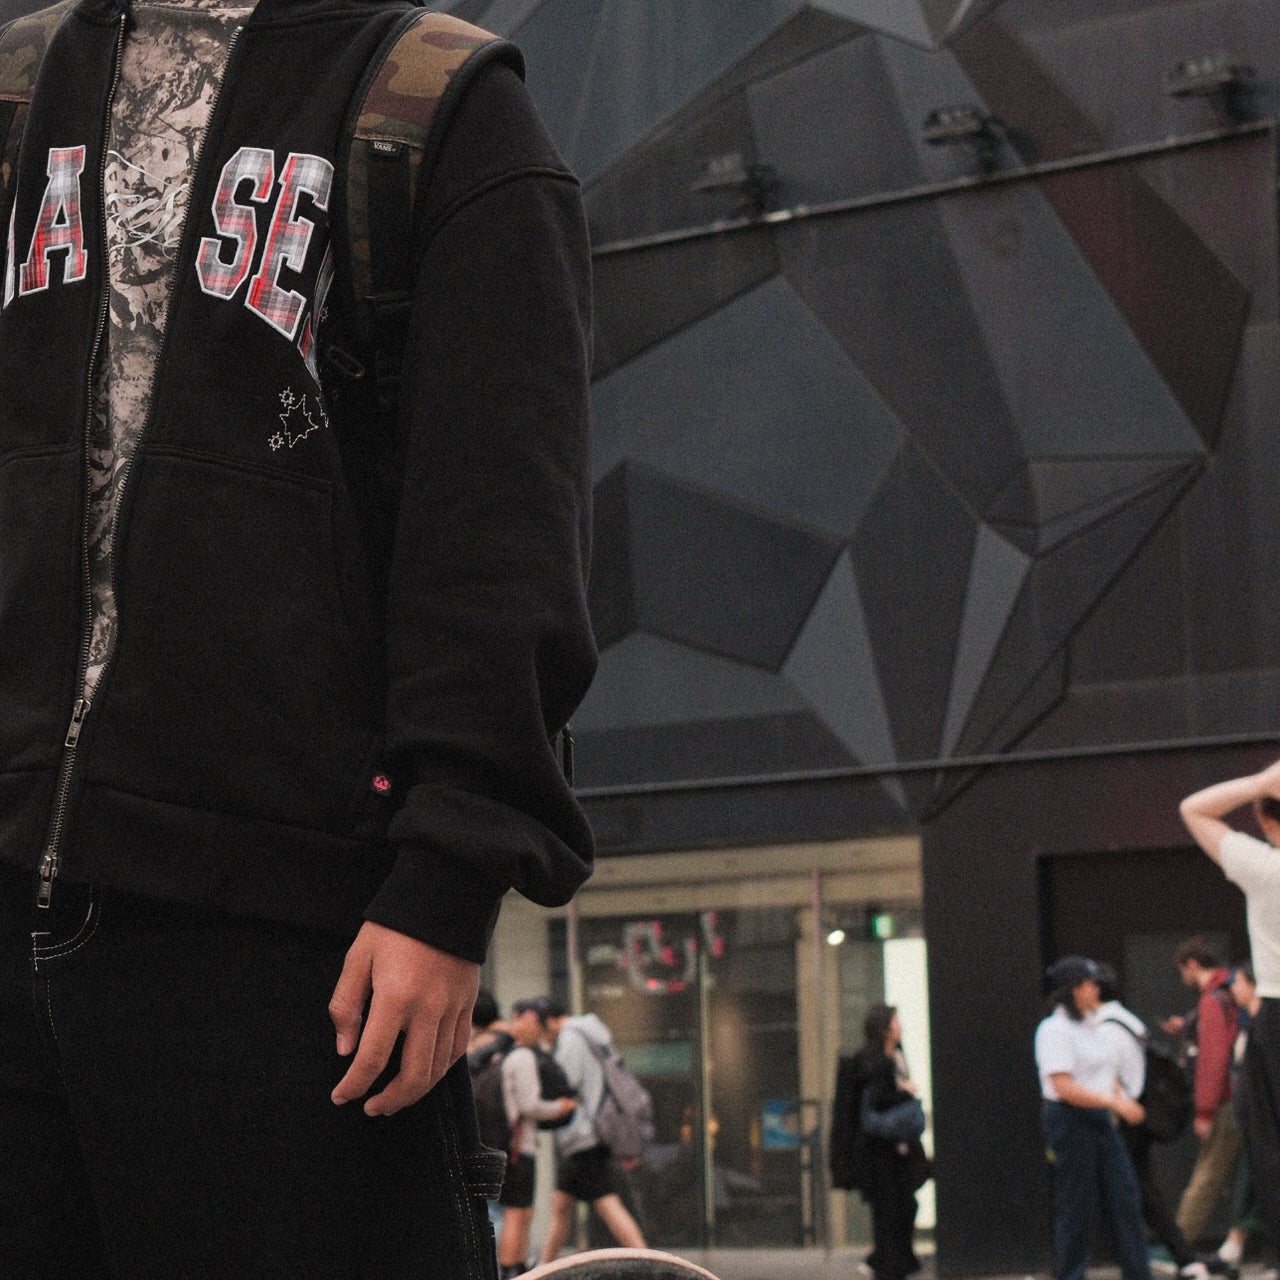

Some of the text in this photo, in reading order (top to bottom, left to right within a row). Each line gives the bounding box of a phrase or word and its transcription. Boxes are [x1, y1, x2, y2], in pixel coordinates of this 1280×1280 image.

[373, 141, 393, 152] VANS
[4, 145, 336, 370] A SE
